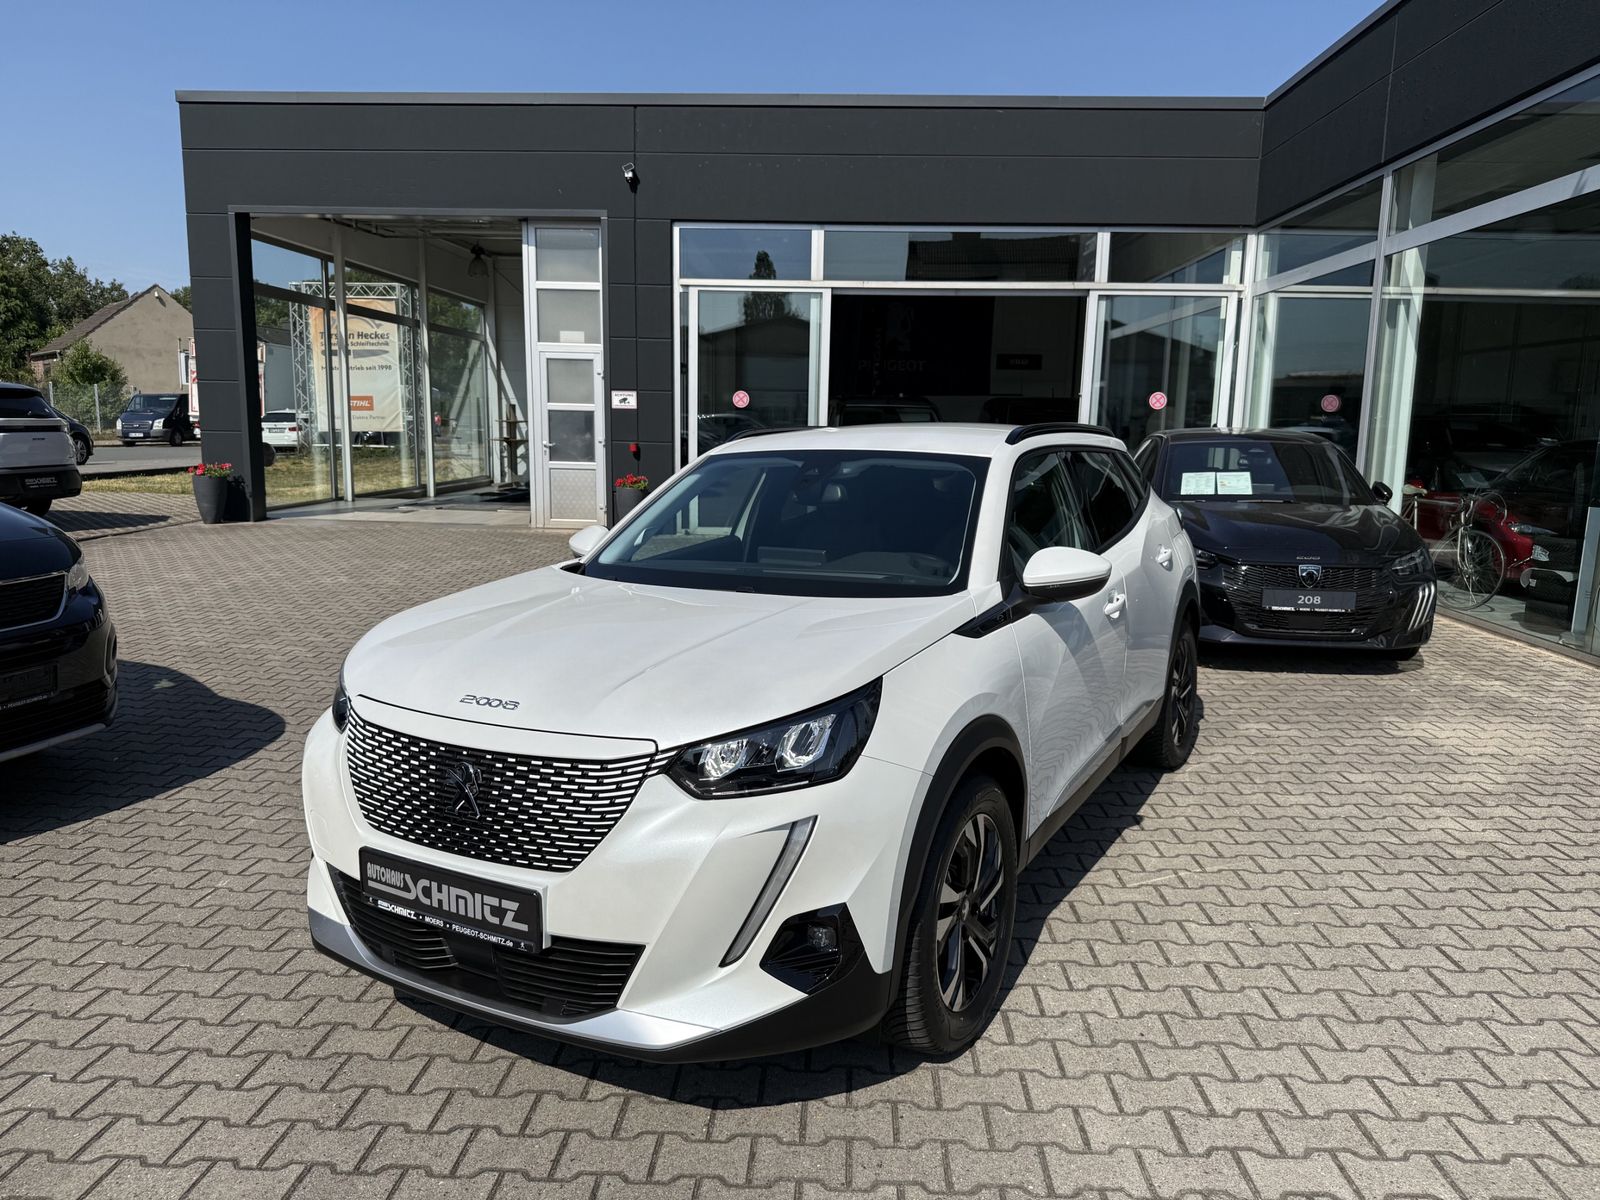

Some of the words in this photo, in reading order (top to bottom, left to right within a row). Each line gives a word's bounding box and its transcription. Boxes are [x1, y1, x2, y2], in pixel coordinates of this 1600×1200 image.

[319, 331, 355, 340] Trsn
[357, 331, 390, 340] Heckes
[1297, 595, 1321, 604] 208
[459, 694, 520, 710] 2008
[367, 862, 404, 888] AUTOHAUS
[368, 873, 529, 932] SCHMITZ
[378, 900, 417, 920] SCHMITZ
[425, 915, 444, 927] MOERS
[451, 924, 514, 947] PEUGEOT-SCHMITZ.de
